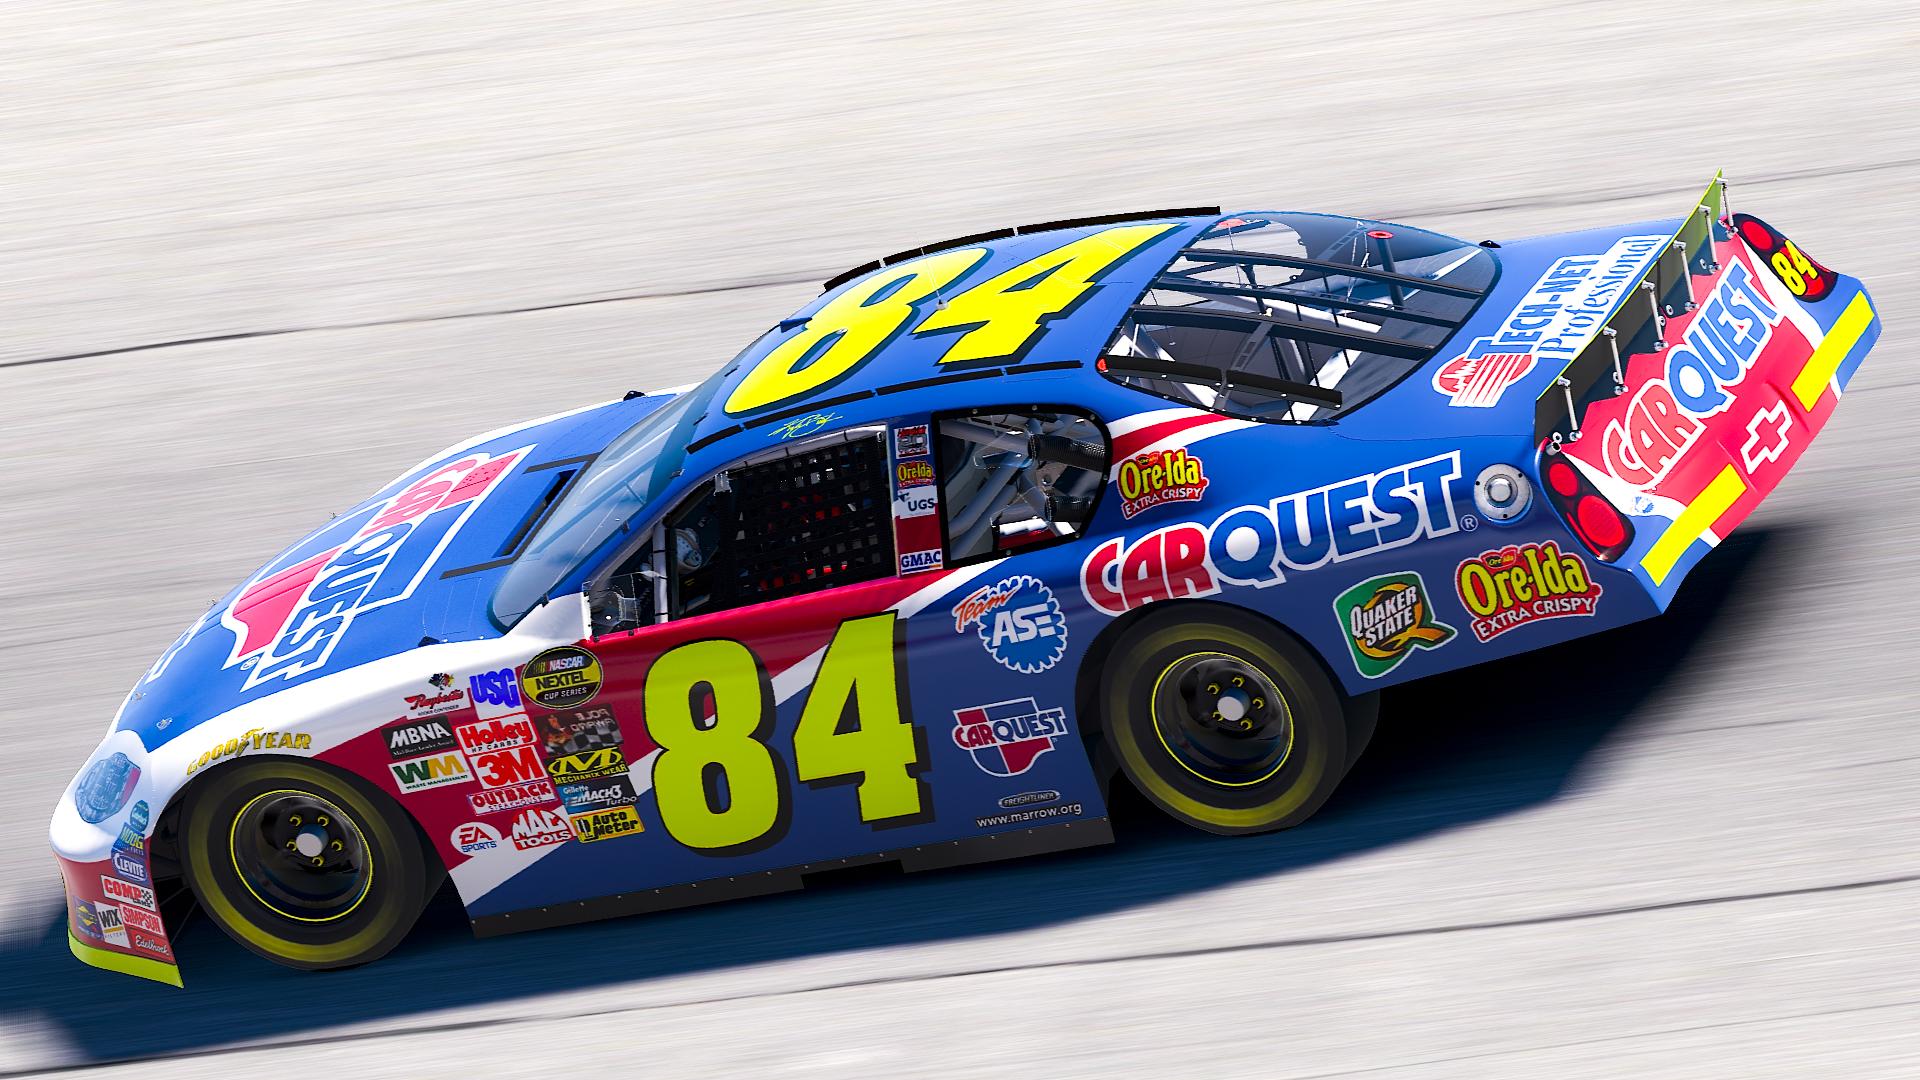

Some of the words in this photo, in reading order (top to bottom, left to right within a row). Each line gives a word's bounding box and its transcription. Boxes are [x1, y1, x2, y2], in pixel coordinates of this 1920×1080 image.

[1771, 240, 1819, 297] 84
[1467, 258, 1600, 360] TECH-NET
[1537, 238, 1664, 354] Professional
[724, 222, 1187, 415] 84
[1603, 257, 1783, 489] CARQUEST
[1120, 450, 1201, 500] Ore-Ida
[908, 498, 936, 512] UGS
[1124, 493, 1160, 516] EXTRA
[1161, 487, 1202, 500] CRISPY
[1080, 450, 1464, 618] CARQUEST
[901, 550, 942, 568] GMAC
[1460, 545, 1589, 616] Ore-Ida
[953, 587, 1018, 633] Team
[1350, 585, 1418, 639] QUAKER
[1476, 606, 1532, 638] EXTRA
[1532, 597, 1594, 615] CRISPY
[992, 603, 1057, 647] ASE
[1365, 605, 1414, 647] STATE
[548, 655, 585, 672] NASCAR
[469, 668, 522, 709] USG
[535, 670, 592, 691] NEXTEL
[544, 691, 559, 701] CUP
[560, 686, 588, 698] SERIES
[390, 722, 453, 749] MBNA
[459, 717, 535, 749] Holley
[642, 610, 930, 853] 84
[953, 709, 1069, 750] CARQUEST
[392, 753, 465, 785] WM
[476, 747, 544, 787] 3M
[553, 771, 600, 785] MECHANIX
[602, 763, 628, 776] WEAR
[473, 781, 552, 808] OUTBACK
[562, 783, 589, 795] Gillette
[578, 783, 622, 803] MACH3
[512, 809, 563, 840] MAC
[592, 811, 627, 826] Auto
[592, 819, 639, 837] Meter
[976, 802, 1083, 828] www.marrow.org
[459, 826, 493, 845] EA
[461, 840, 498, 853] SPORTS
[517, 830, 572, 849] TOOLS
[114, 852, 145, 878] CLEVITE
[103, 878, 142, 901] COMP
[98, 908, 122, 928] WIX
[122, 906, 160, 933] SIMPSON
